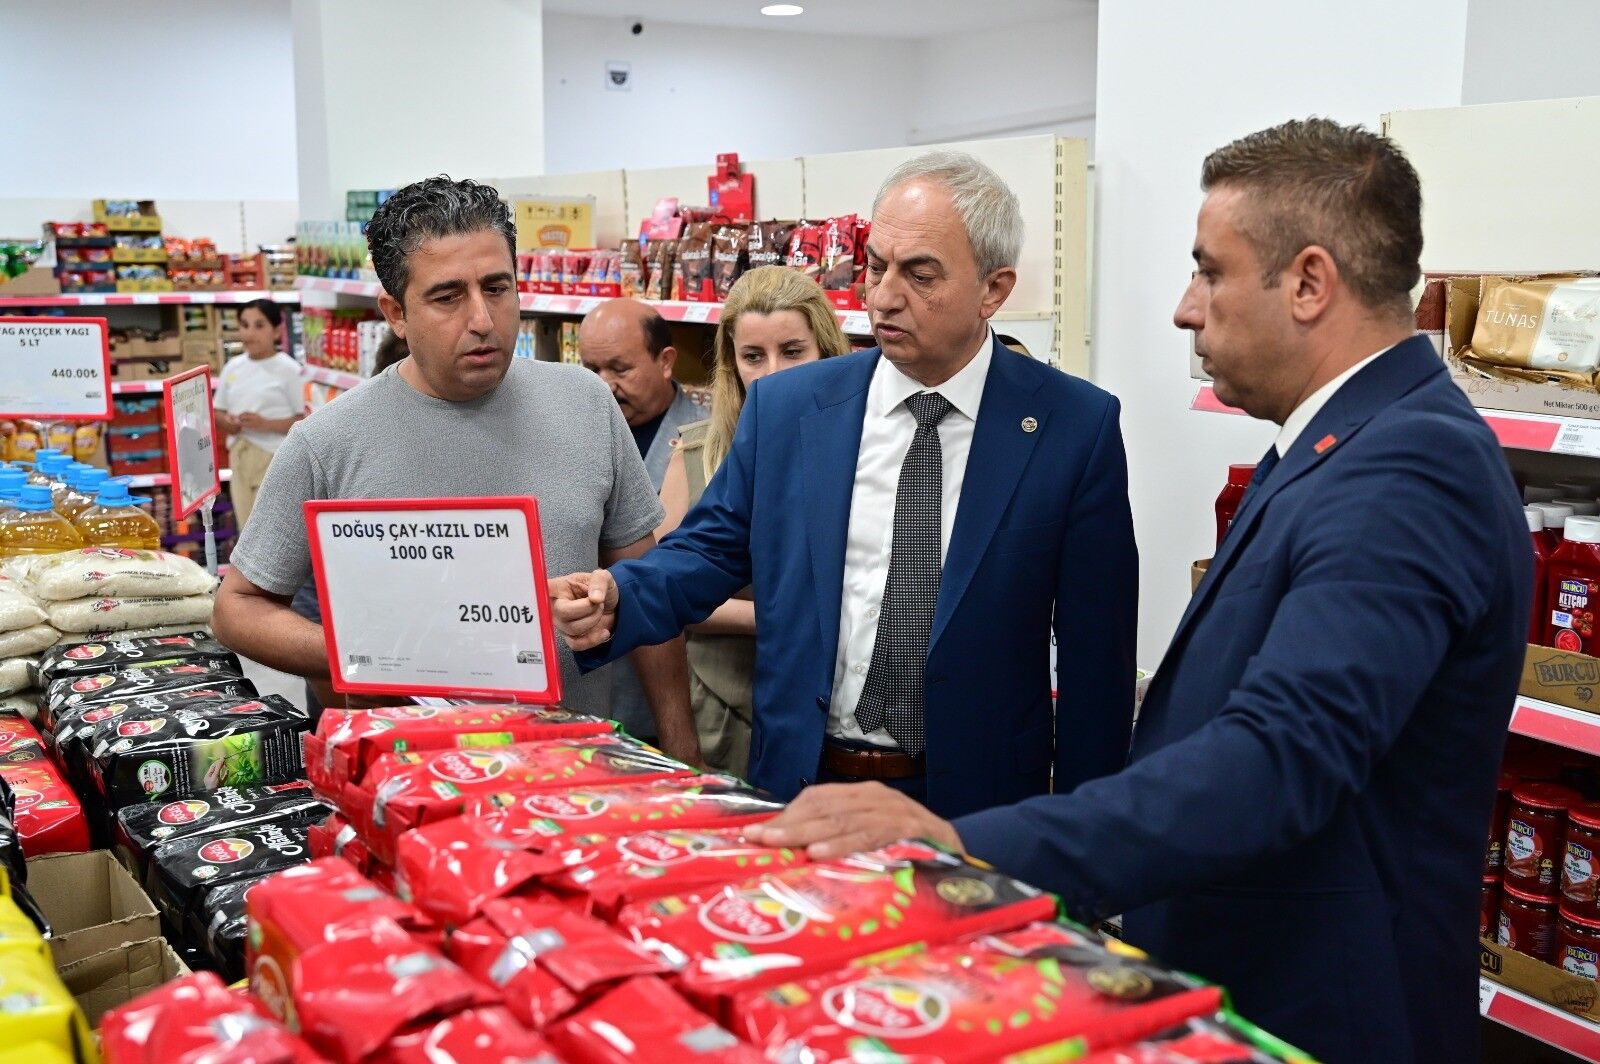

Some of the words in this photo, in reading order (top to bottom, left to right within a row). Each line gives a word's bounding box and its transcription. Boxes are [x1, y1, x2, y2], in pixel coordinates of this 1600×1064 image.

[1485, 310, 1538, 329] TUNAS
[0, 327, 15, 335] AG
[20, 339, 26, 347] 5
[29, 339, 40, 347] LT
[51, 368, 98, 378] 440.00₺
[1543, 400, 1555, 408] Net
[1575, 402, 1588, 411] 500
[332, 520, 385, 541] DOĞUŞ
[389, 523, 470, 541] ÇAY-KIZIL
[474, 523, 510, 538] DEM
[390, 545, 427, 560] 1000
[432, 545, 455, 560] GR
[1558, 592, 1588, 608] KETÇAP
[458, 604, 534, 624] 250.00₺
[1538, 662, 1597, 682] BURCU
